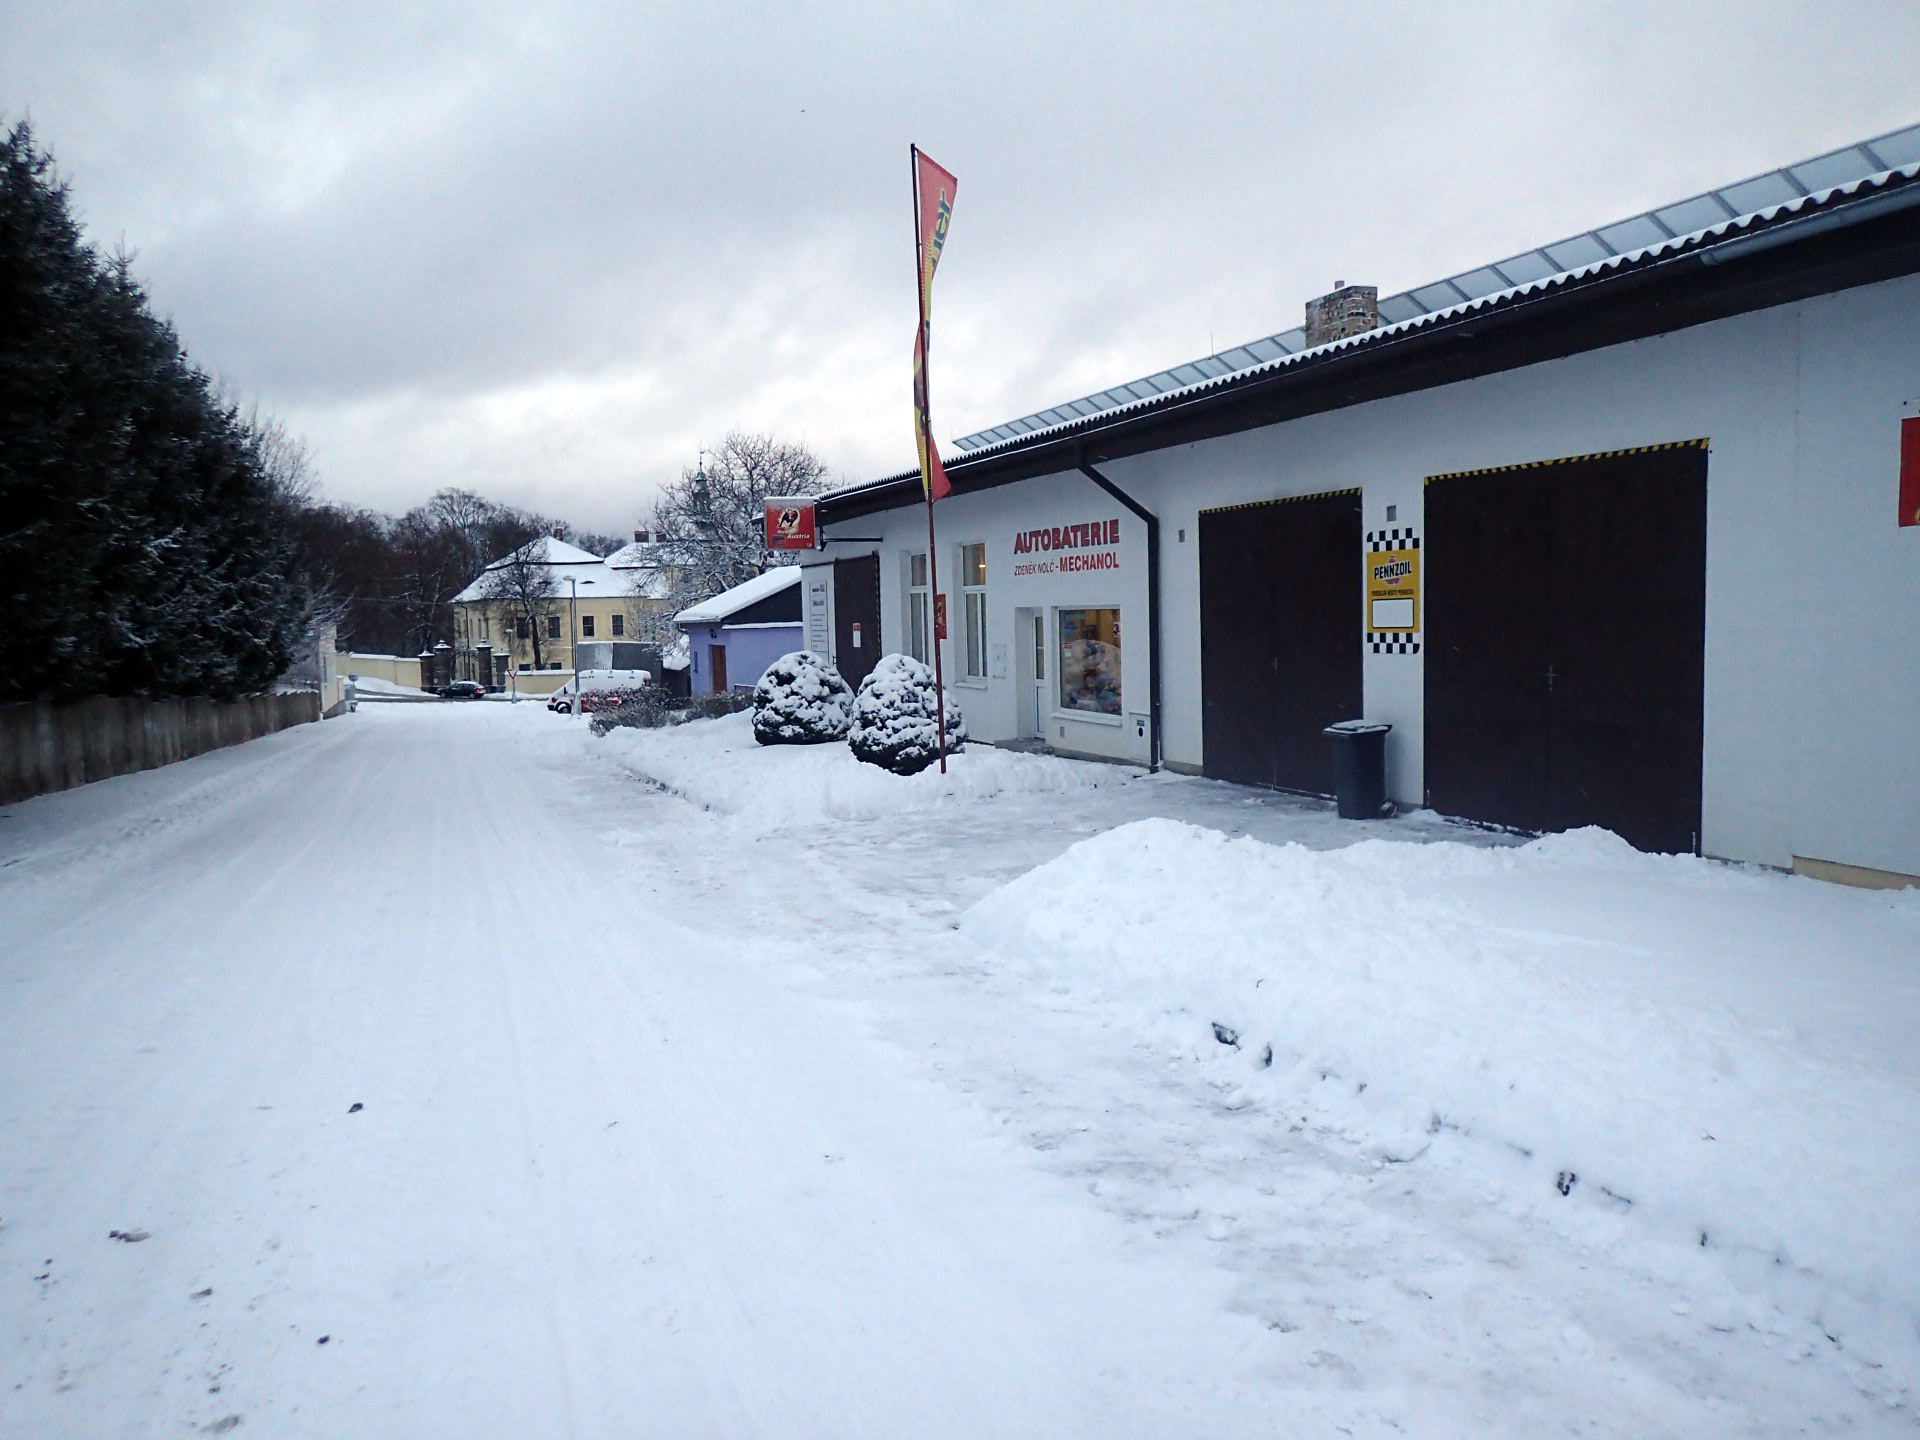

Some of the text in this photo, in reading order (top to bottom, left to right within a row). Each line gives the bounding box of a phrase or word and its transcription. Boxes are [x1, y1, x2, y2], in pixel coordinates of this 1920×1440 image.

[1014, 519, 1119, 554] AUTOBATERIE
[1060, 552, 1119, 572] MECHANOL
[1374, 560, 1412, 580] PENNZOIL
